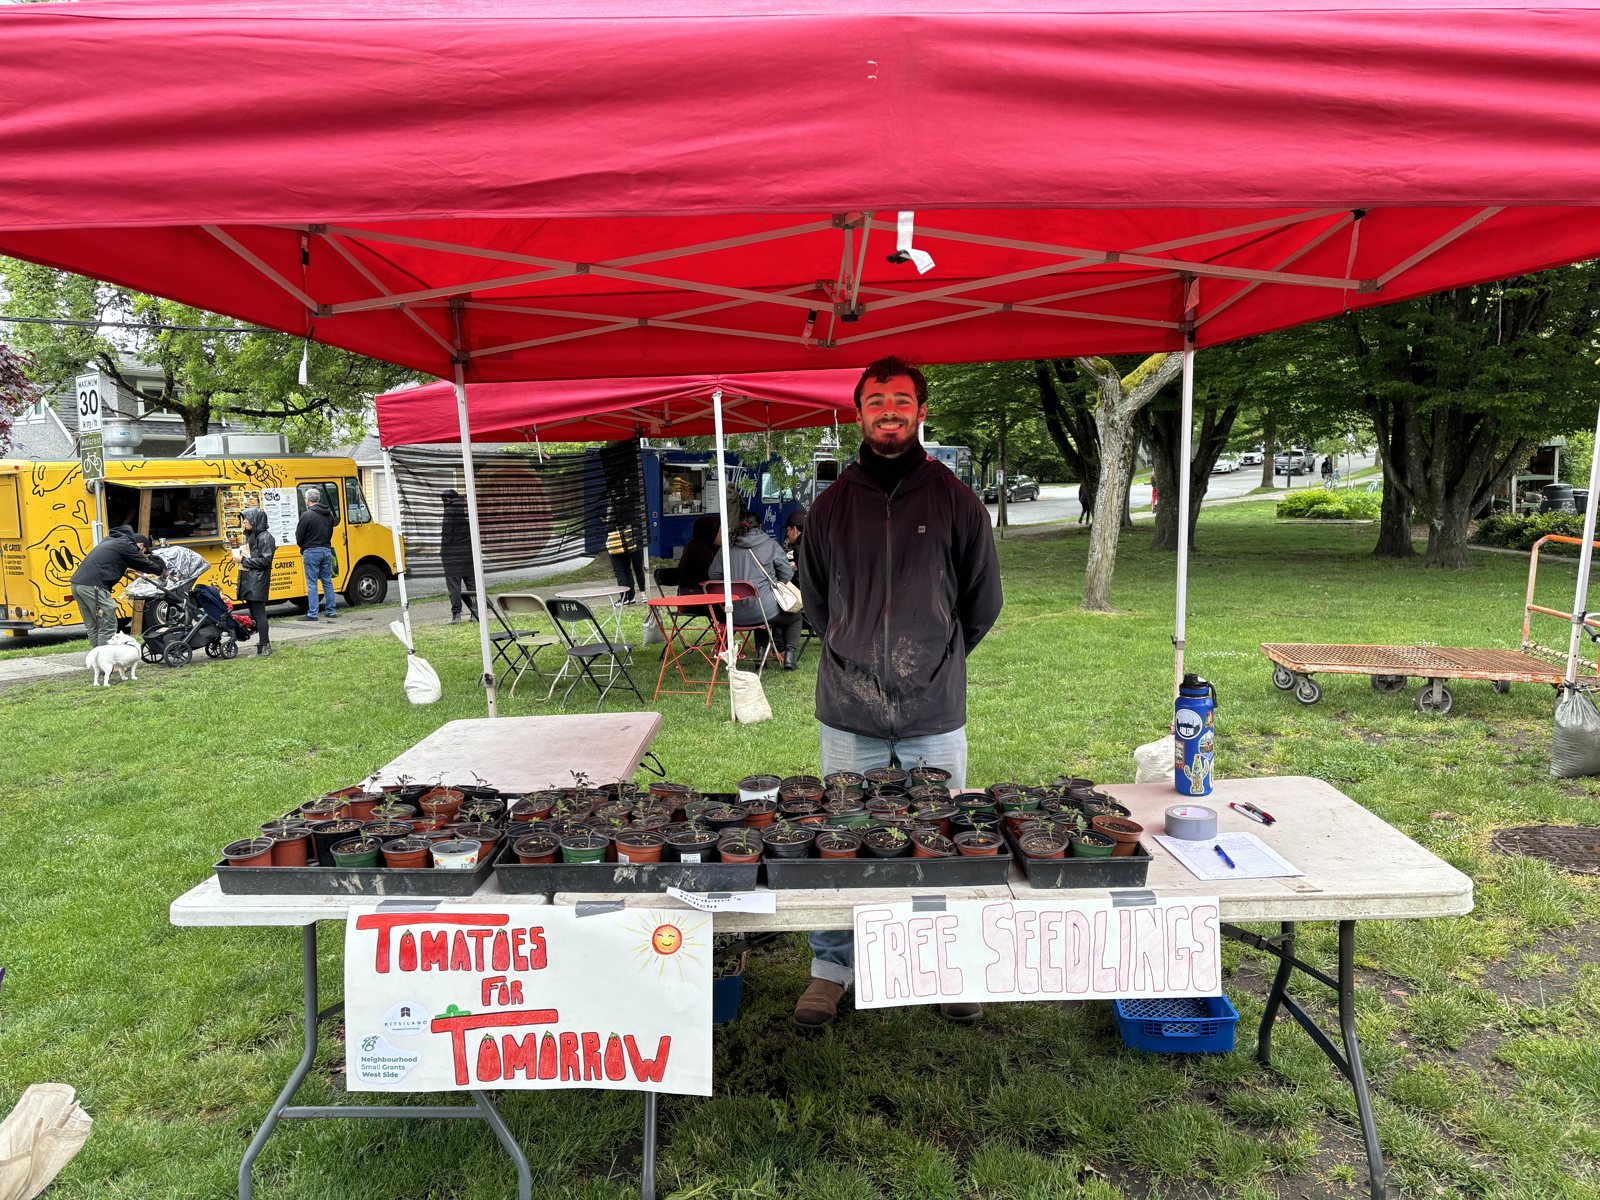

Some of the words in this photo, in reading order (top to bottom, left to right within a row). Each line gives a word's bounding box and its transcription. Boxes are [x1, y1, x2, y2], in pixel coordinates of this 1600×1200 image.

[78, 379, 98, 388] MAXIMUM
[80, 389, 99, 416] 30
[83, 418, 98, 428] km/h
[561, 603, 578, 612] VFM
[356, 913, 548, 973] TOMATOES
[856, 909, 963, 1002] FREE
[982, 902, 1218, 994] SEEDLINGS
[481, 976, 524, 1006] FOR
[430, 1009, 671, 1086] TOMORROW
